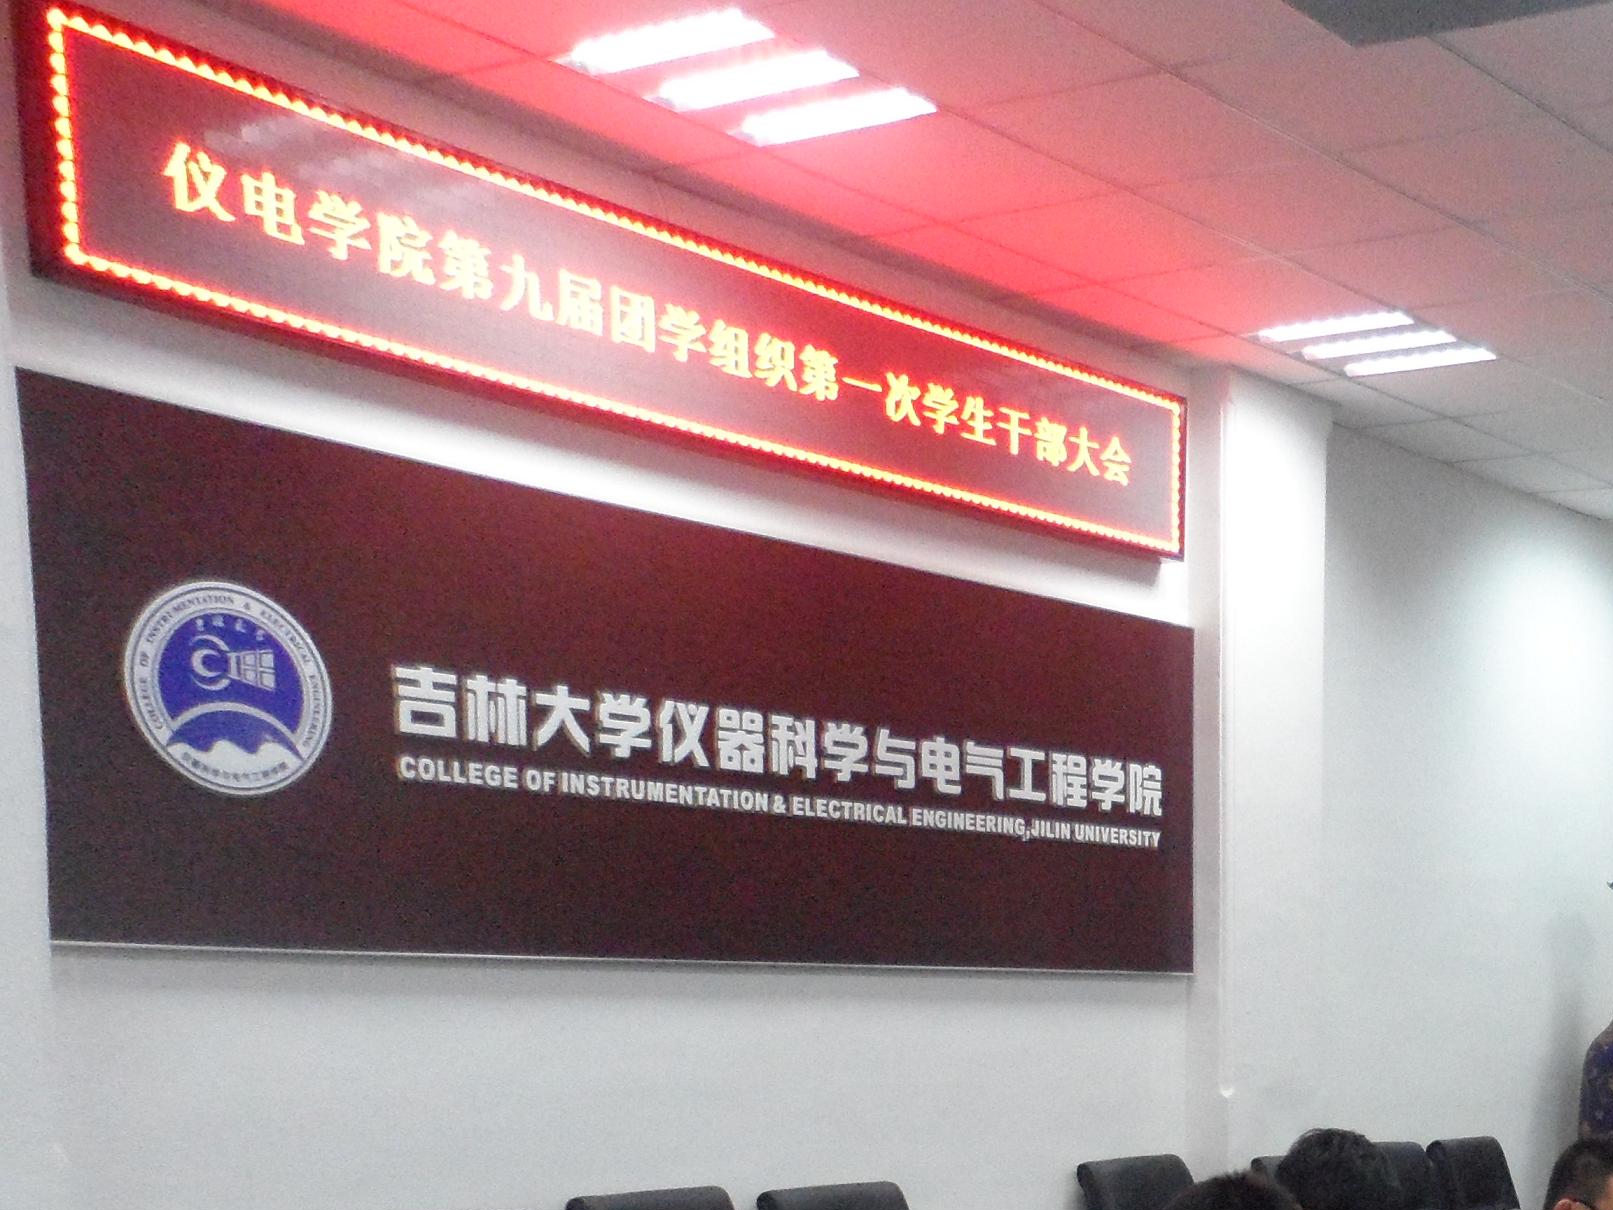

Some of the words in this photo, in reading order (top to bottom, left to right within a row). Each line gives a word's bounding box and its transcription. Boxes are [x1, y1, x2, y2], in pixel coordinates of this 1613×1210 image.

[162, 140, 1133, 487] 仪电学院第九届团学组织第一次学生干部大会
[392, 664, 1163, 818] 吉林大学仪器科学与电气工程学院
[398, 754, 519, 791] COLLEGE
[526, 769, 557, 794] OF
[561, 771, 769, 814] INSTRUMENTATION
[771, 795, 788, 815] &
[791, 796, 907, 826] ELECTRICAL
[1074, 824, 1162, 849] UNIVERSITY
